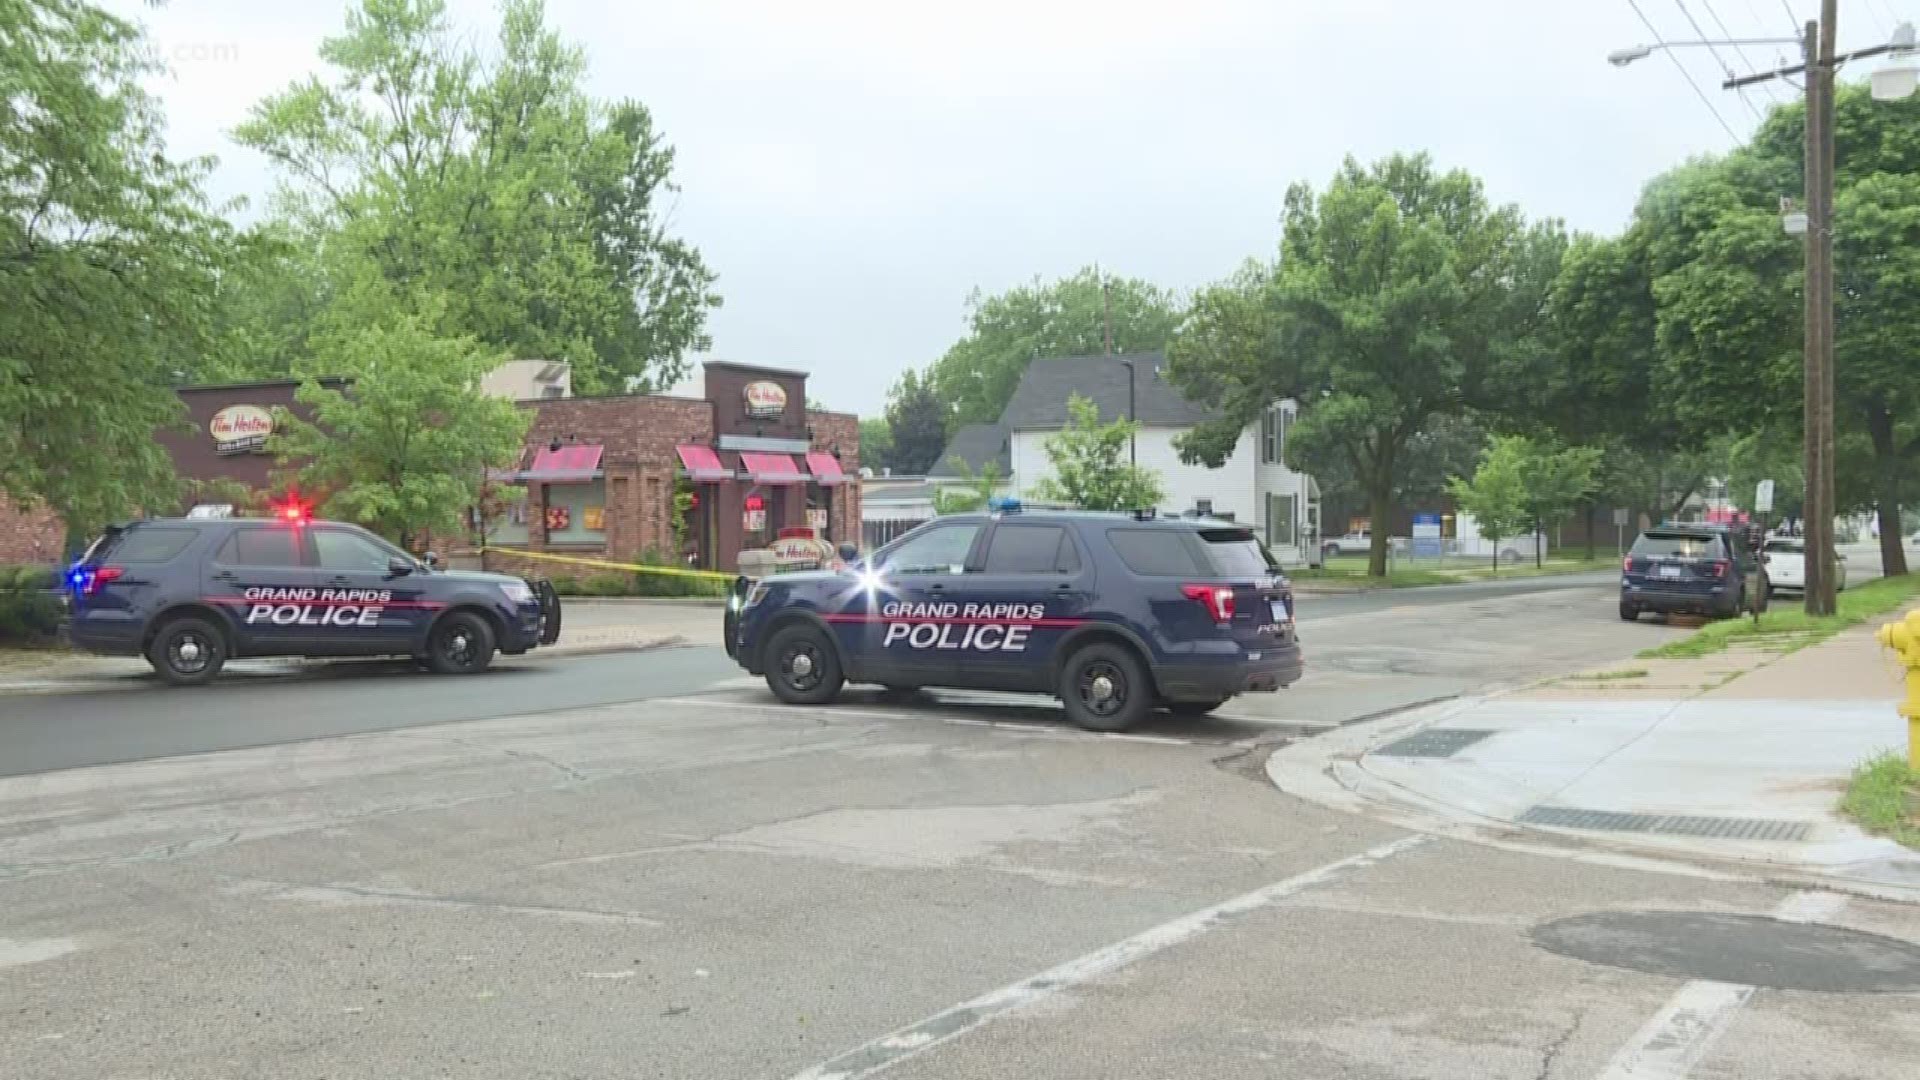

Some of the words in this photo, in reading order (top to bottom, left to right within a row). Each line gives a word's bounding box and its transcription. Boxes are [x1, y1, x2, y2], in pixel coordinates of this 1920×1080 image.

[213, 414, 232, 433] Tim
[244, 586, 316, 601] GRAND
[320, 588, 393, 603] RAPIDS
[246, 604, 385, 626] POLICE
[882, 601, 958, 619] GRAND
[962, 603, 1046, 621] RAPIDS
[883, 623, 1033, 651] POLICE
